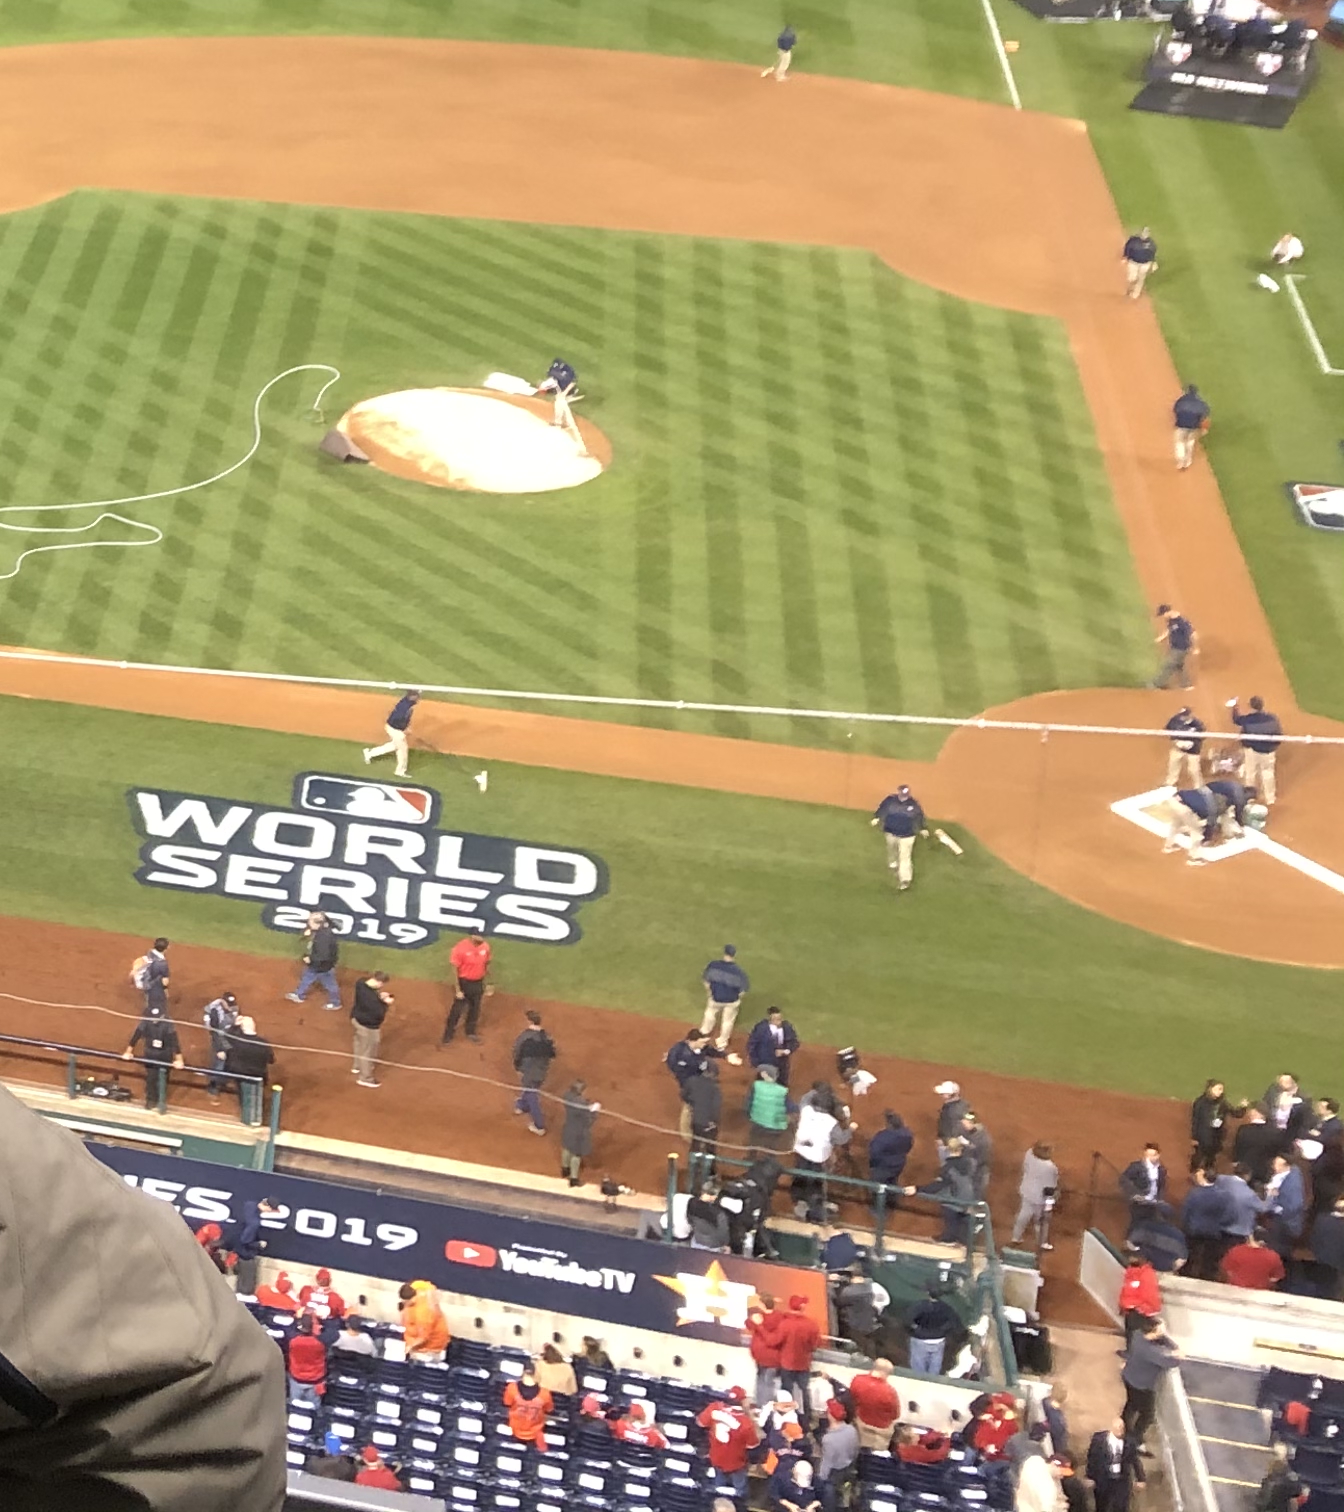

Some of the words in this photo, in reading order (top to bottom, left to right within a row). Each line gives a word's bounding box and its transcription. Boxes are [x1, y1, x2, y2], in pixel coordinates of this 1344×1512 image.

[136, 791, 598, 897] WORLD
[146, 843, 571, 942] SERIES
[259, 1204, 419, 1251] 2019
